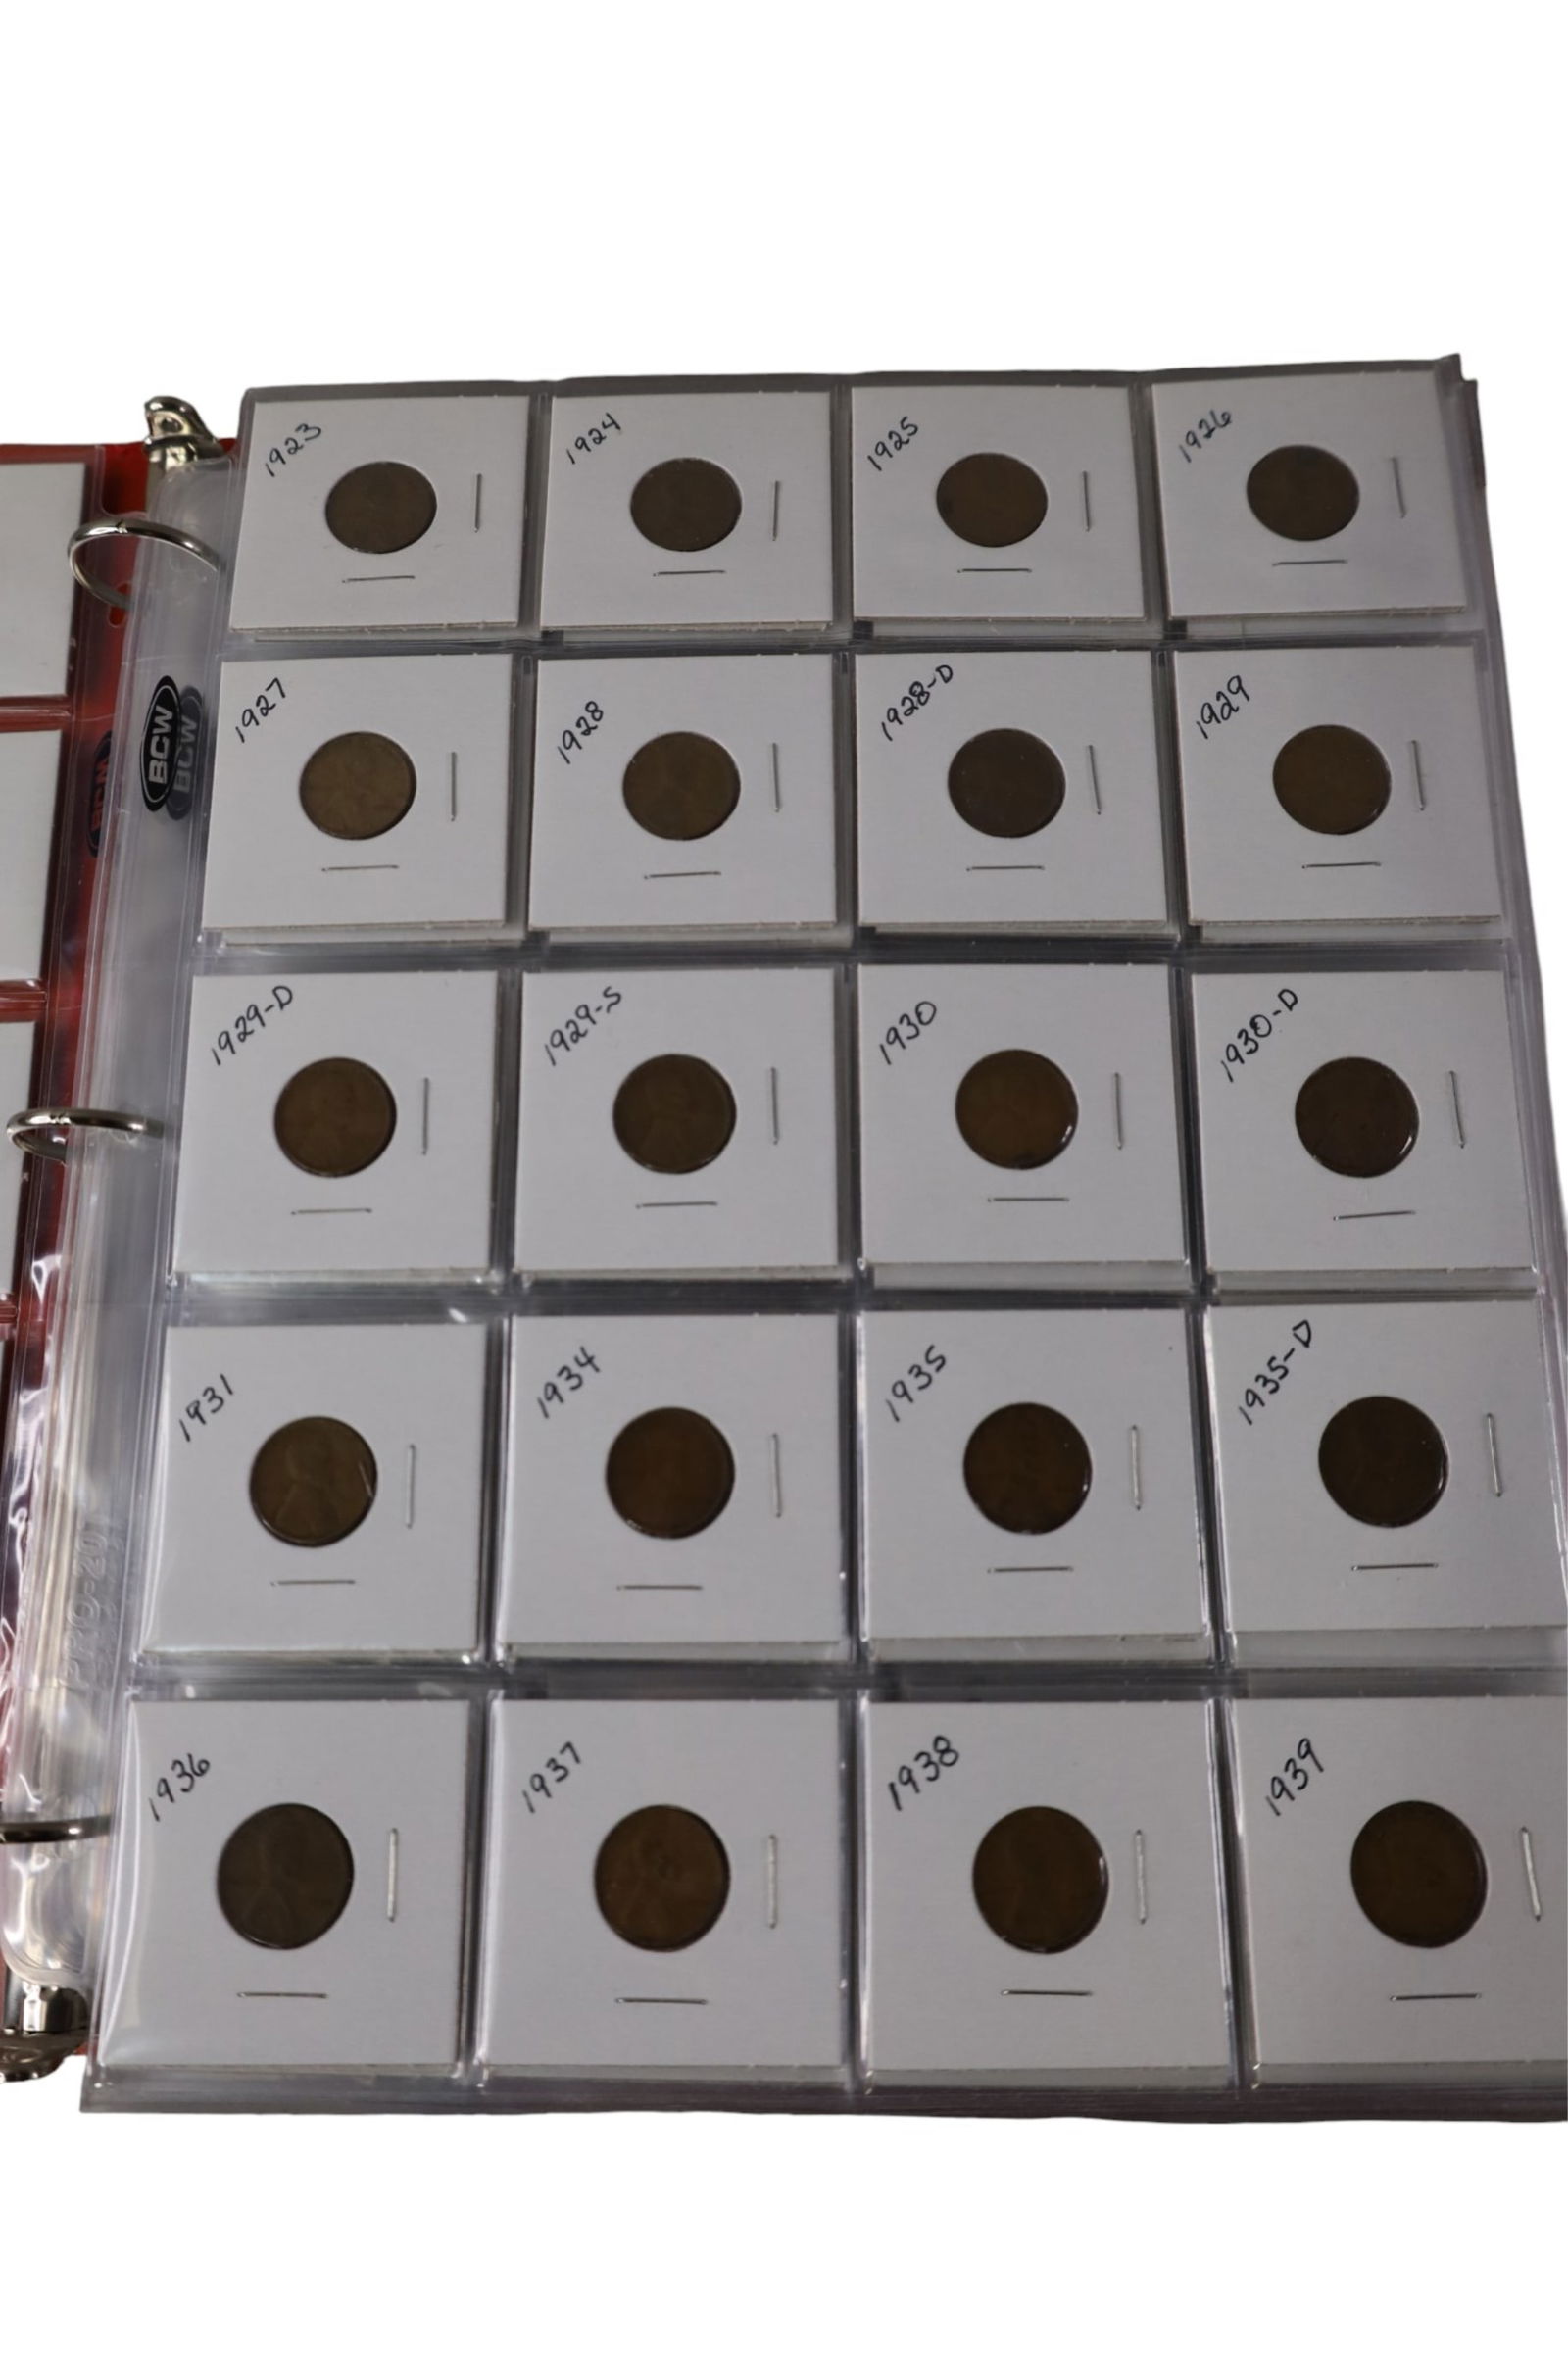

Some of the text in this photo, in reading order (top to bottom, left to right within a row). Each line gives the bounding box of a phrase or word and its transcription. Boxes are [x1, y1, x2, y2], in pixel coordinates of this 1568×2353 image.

[265, 423, 322, 478] 1923
[566, 412, 621, 465] 1924
[867, 416, 919, 471] 1925
[1178, 410, 1232, 463] 1926
[235, 676, 286, 744] 1927
[557, 700, 605, 765] 1928
[881, 664, 954, 742] 1928-D
[1196, 674, 1250, 740] 1929
[148, 705, 174, 785] BCW
[173, 714, 198, 793] BCW
[212, 985, 295, 1067] 1929-D
[544, 986, 622, 1067] 1929-S
[879, 1000, 938, 1066] 1930
[1220, 988, 1299, 1084] 1930-D
[179, 1373, 234, 1443] 1931
[537, 1346, 601, 1419] 1934
[887, 1344, 947, 1423] 1935
[1238, 1319, 1312, 1426] 1935-D
[148, 1753, 211, 1822] 1936
[521, 1741, 581, 1814] 1937
[888, 1735, 960, 1812] 1938
[1266, 1737, 1325, 1817] 1939
